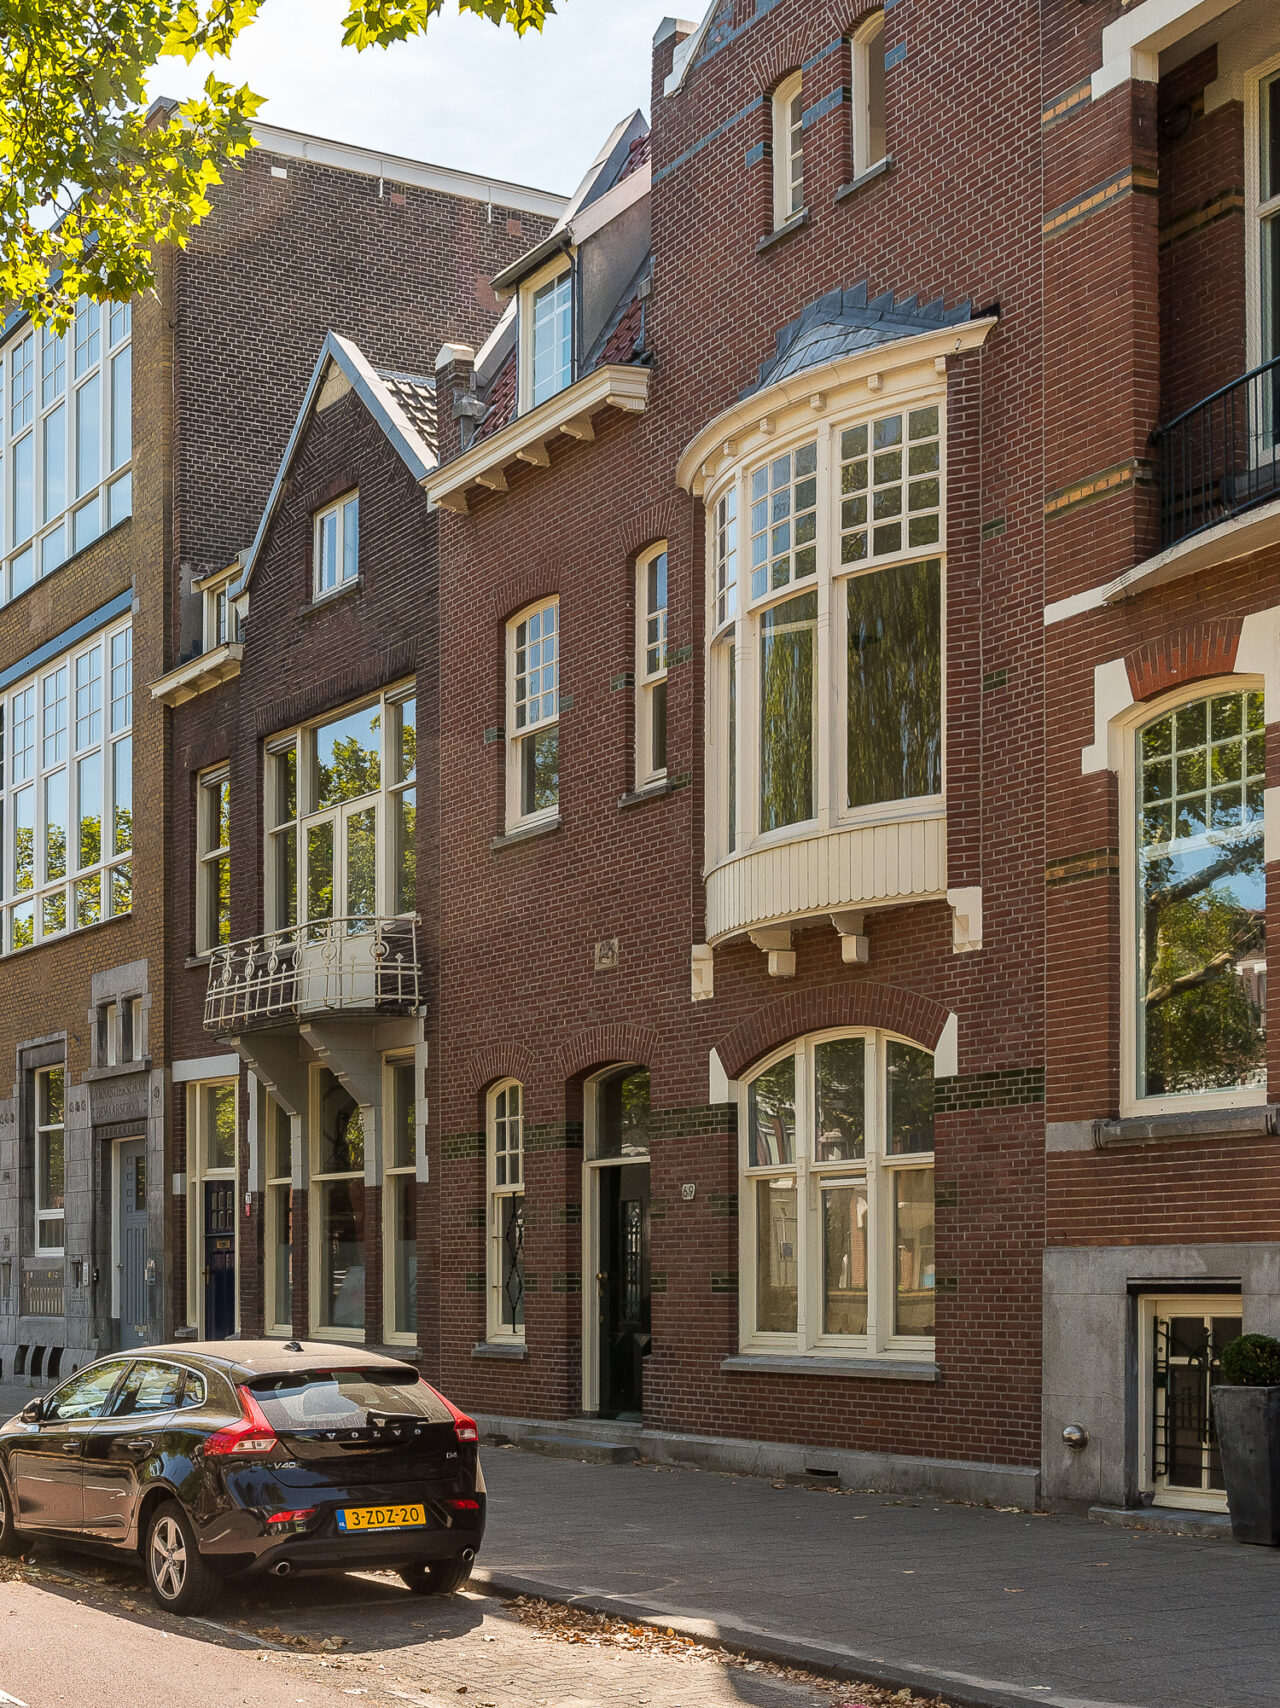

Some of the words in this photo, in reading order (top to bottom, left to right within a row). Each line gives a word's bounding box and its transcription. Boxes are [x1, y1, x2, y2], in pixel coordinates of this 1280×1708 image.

[327, 1429, 421, 1440] VOLVO
[274, 1462, 296, 1470] V40
[351, 1507, 420, 1526] 3-ZDZ-20
